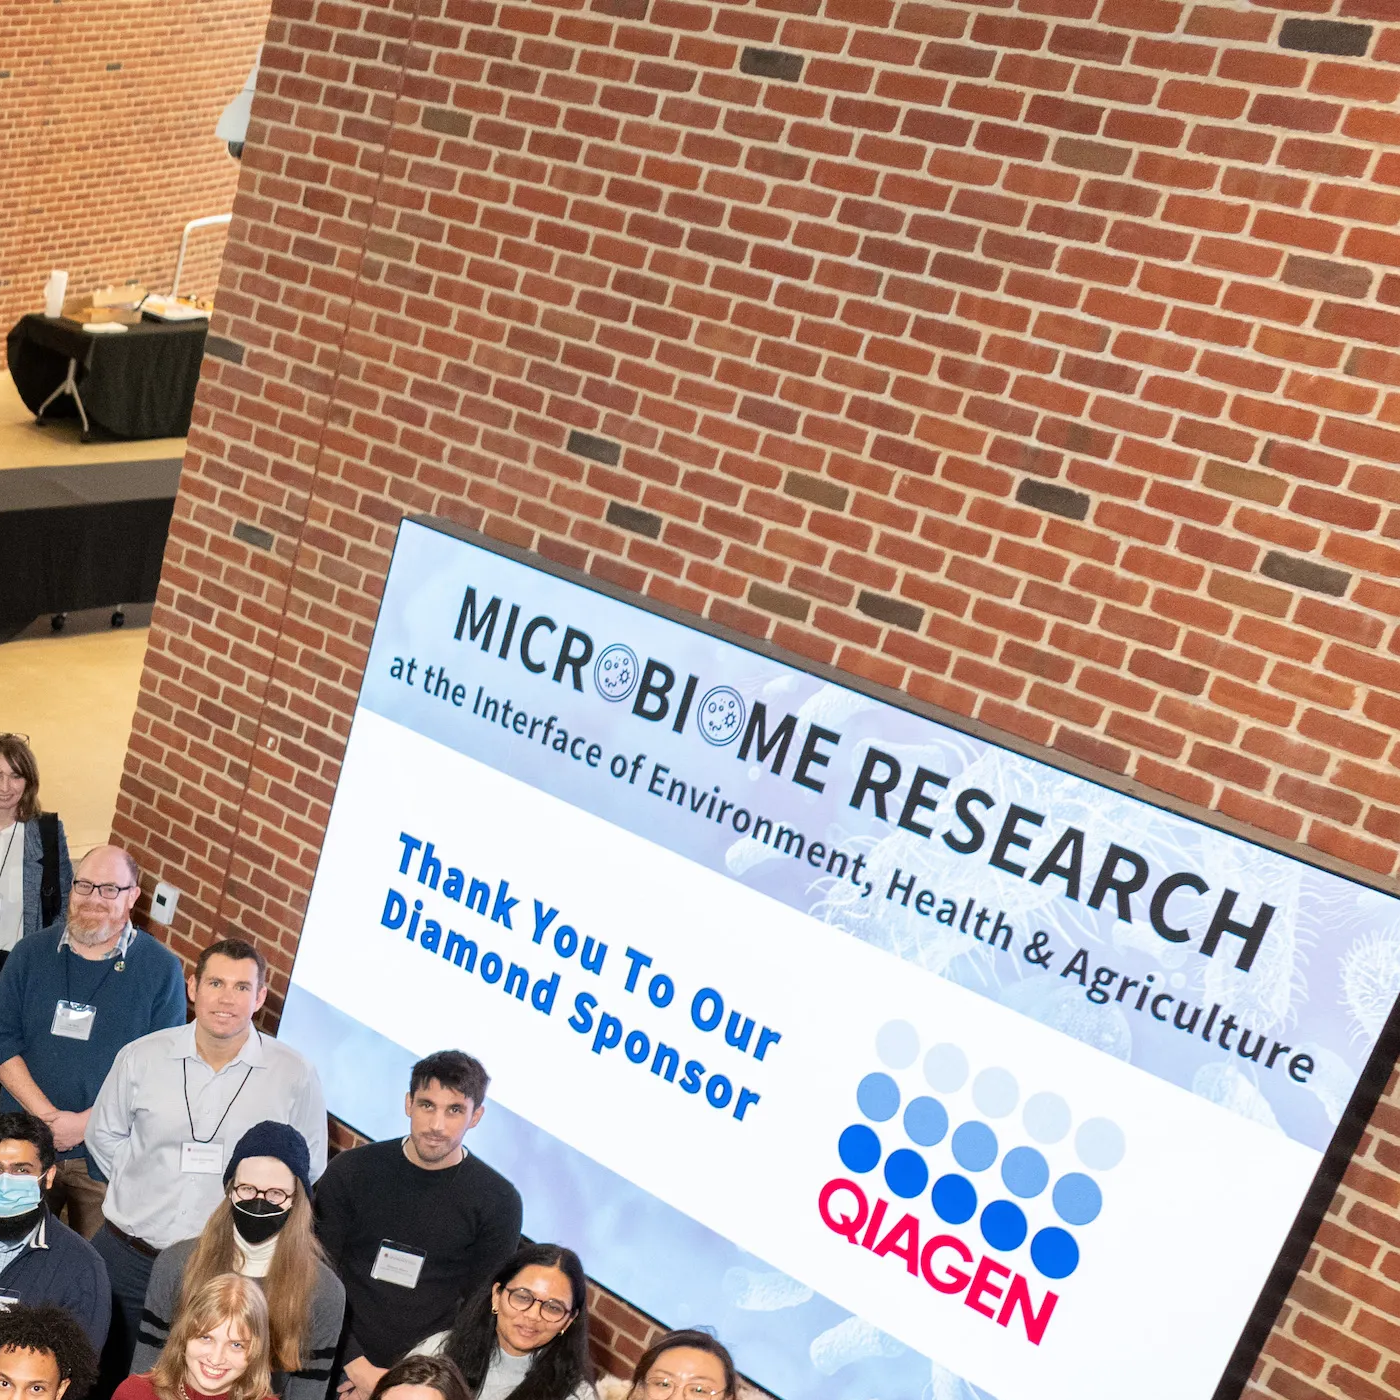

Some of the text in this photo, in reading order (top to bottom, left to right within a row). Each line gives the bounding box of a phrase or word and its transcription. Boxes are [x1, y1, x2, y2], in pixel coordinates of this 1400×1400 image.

[389, 654, 1316, 1084] at the Interface of Environment, Health & Agriculture
[453, 585, 1277, 973] MICROBIOME RESEARCH
[380, 888, 761, 1122] Diamond Sponsor
[398, 831, 782, 1062] Thank You To Our
[818, 1178, 1059, 1346] QIAGEN
